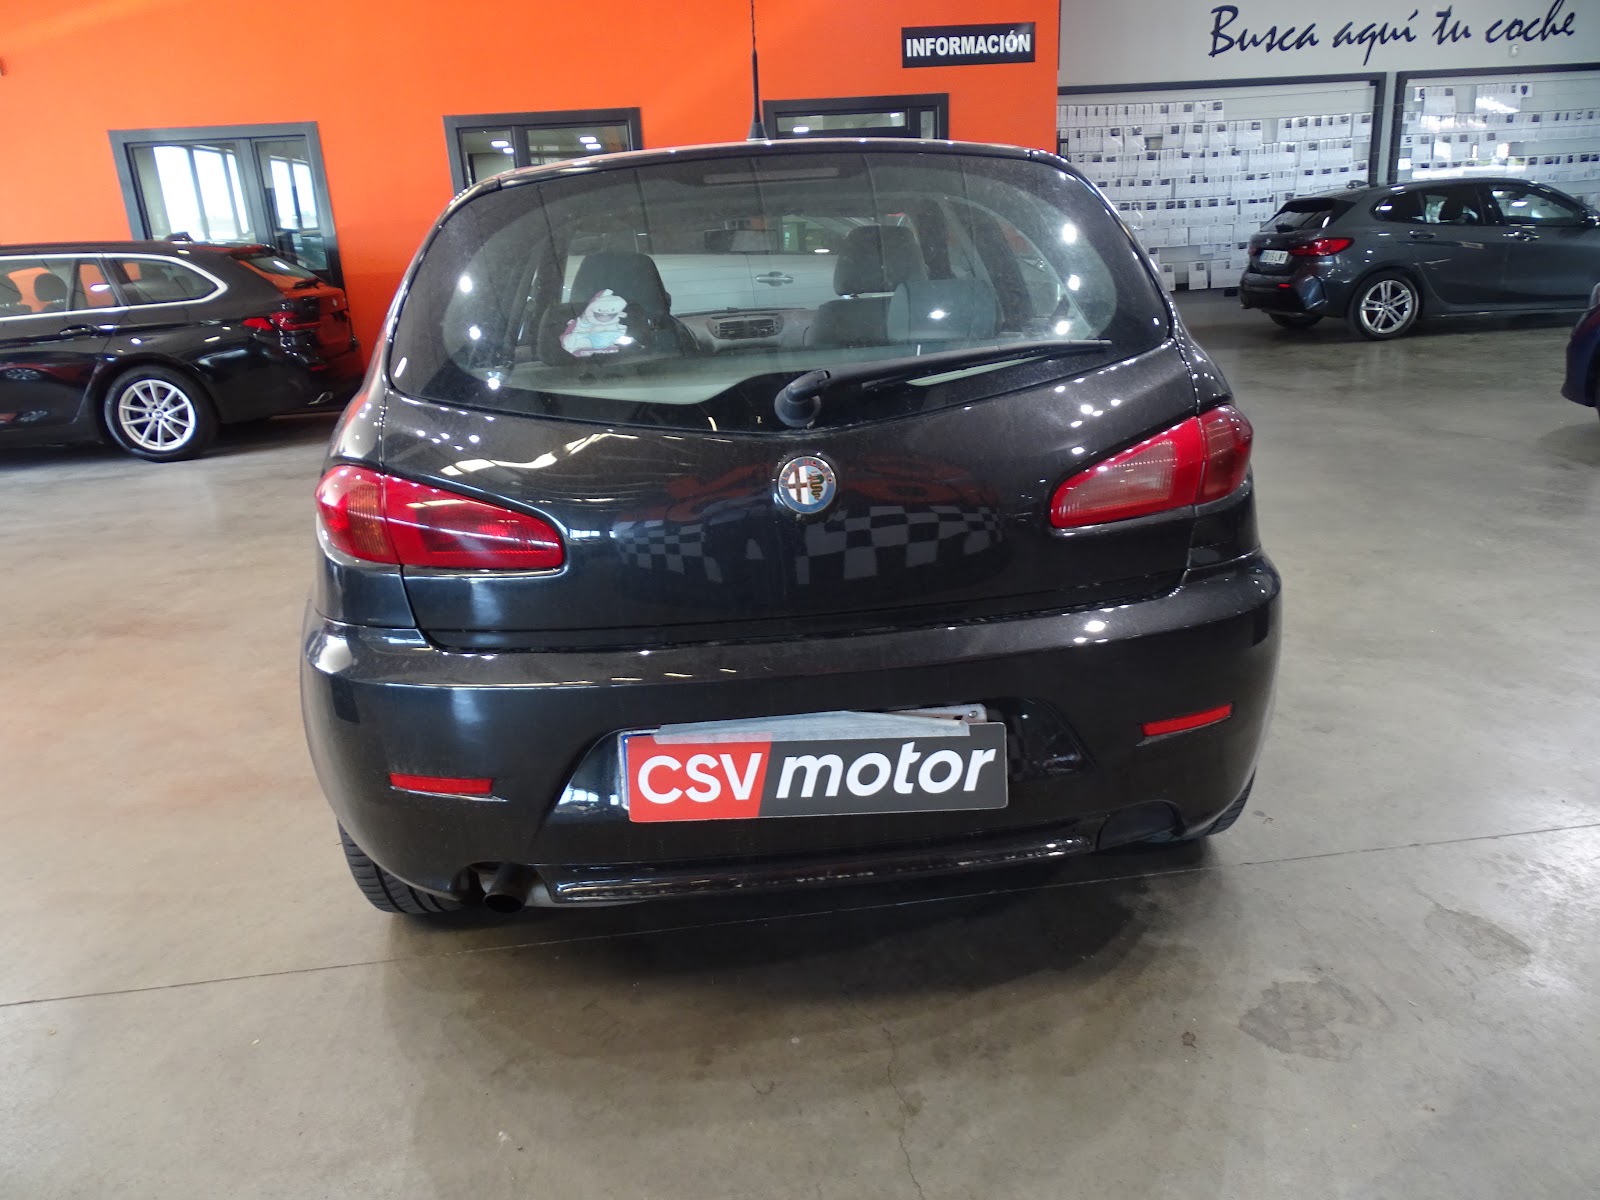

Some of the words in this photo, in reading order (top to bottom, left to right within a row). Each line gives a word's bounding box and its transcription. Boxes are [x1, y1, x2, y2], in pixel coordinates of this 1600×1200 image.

[906, 29, 1031, 57] INFORMACIÓN
[1208, 4, 1320, 58] Busca
[1332, 10, 1418, 66] aquí
[1433, 5, 1472, 45] tu
[1485, 0, 1576, 43] coche
[637, 752, 763, 804] CSV
[776, 741, 997, 799] motor
